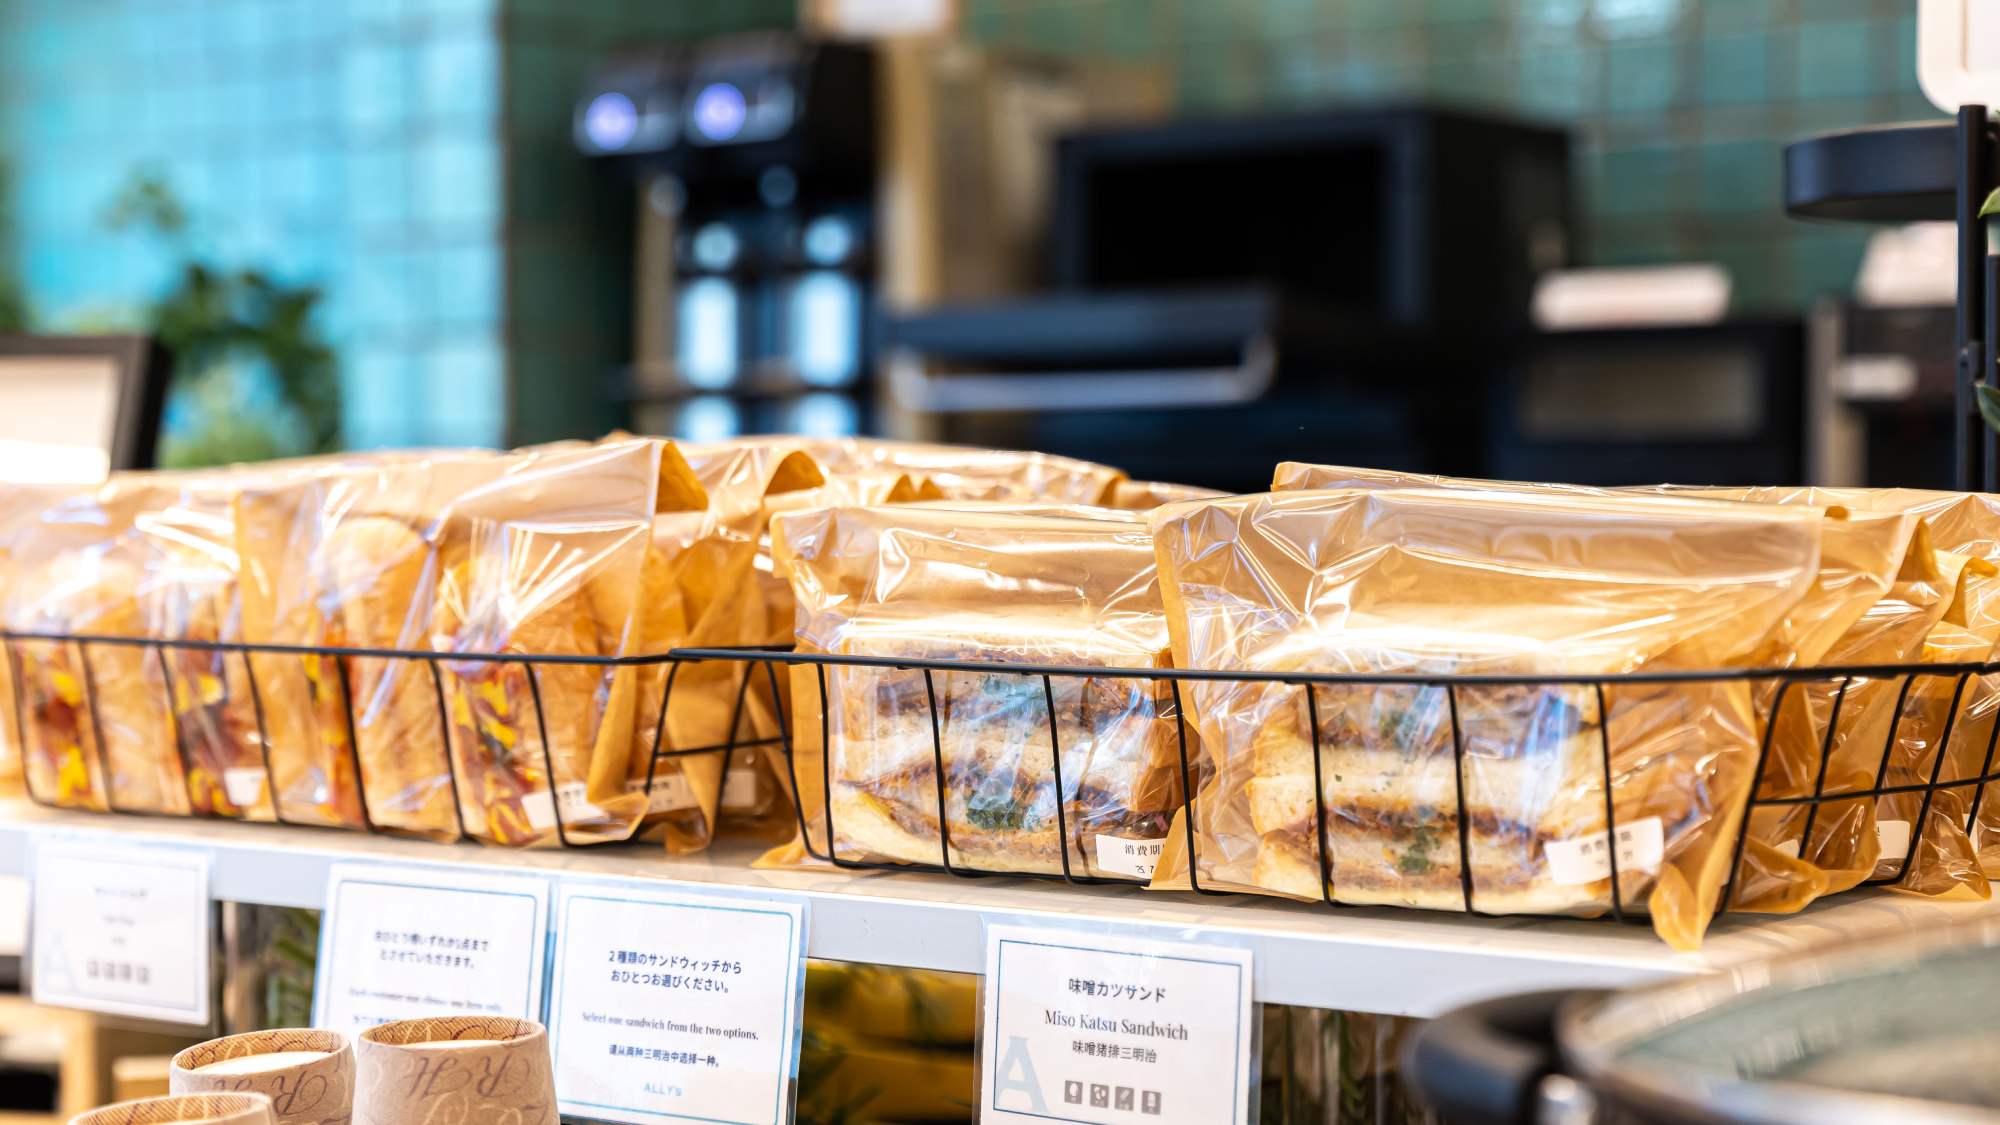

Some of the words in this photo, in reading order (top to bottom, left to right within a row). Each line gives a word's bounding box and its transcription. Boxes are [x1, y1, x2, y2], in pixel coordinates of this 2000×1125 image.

[1125, 843, 1164, 856] 消費期
[611, 970, 729, 993] おひとつお選びください。
[1068, 978, 1166, 1003] 味噌カツサンド
[625, 1017, 665, 1030] sandwich
[667, 1021, 688, 1033] from
[690, 1023, 703, 1034] the
[705, 1025, 721, 1036] two
[723, 1027, 759, 1041] options.
[1045, 1010, 1075, 1027] Miso
[1080, 1014, 1117, 1033] Katsu
[1121, 1019, 1189, 1041] Sandwich
[996, 1034, 1049, 1112] A
